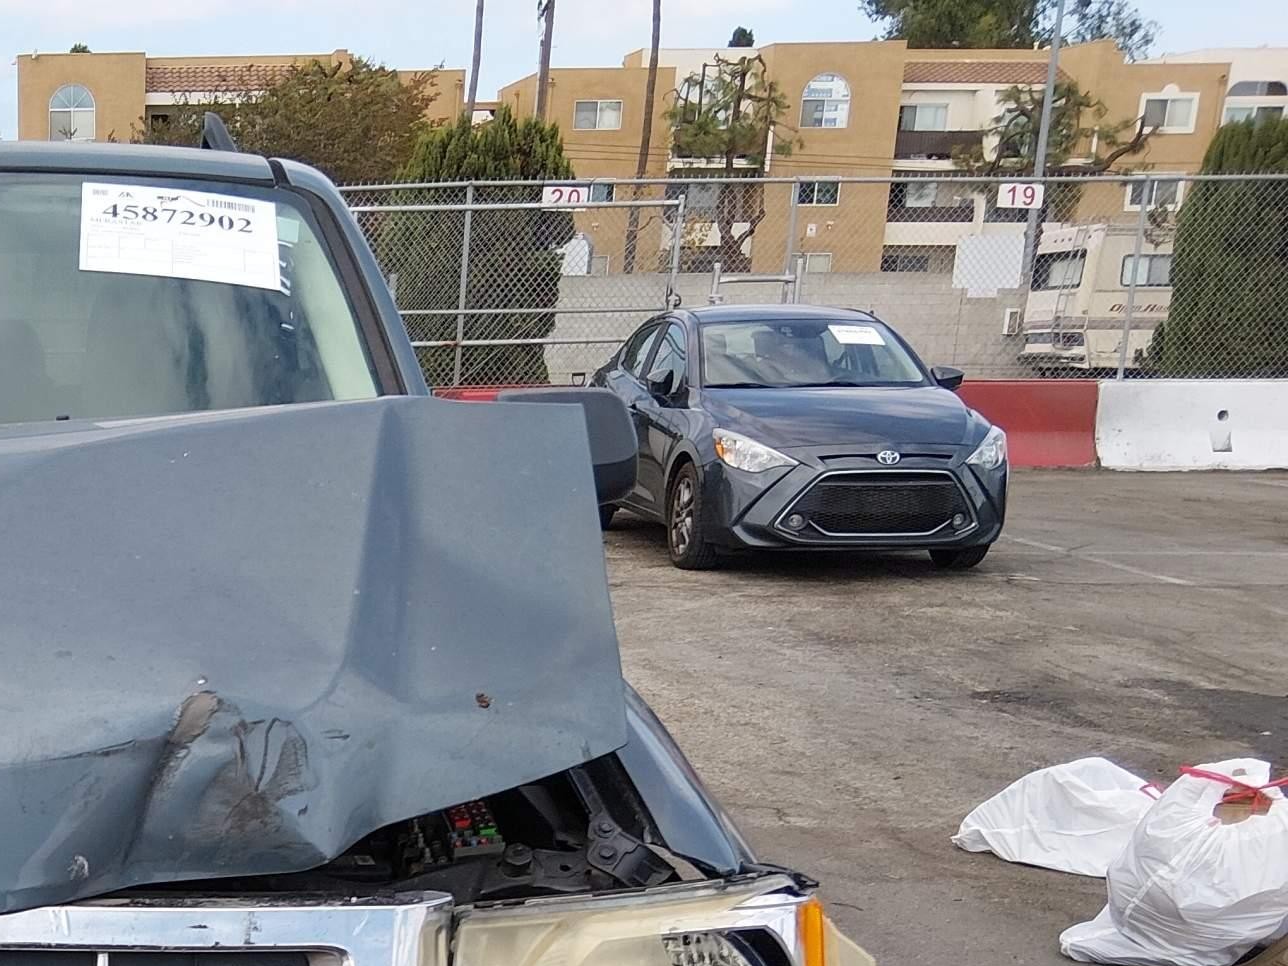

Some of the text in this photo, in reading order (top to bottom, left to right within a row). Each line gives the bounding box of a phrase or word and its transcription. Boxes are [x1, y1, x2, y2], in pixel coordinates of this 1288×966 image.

[551, 188, 581, 204] 20
[1007, 185, 1035, 206] 19
[102, 203, 253, 233] 45872902
